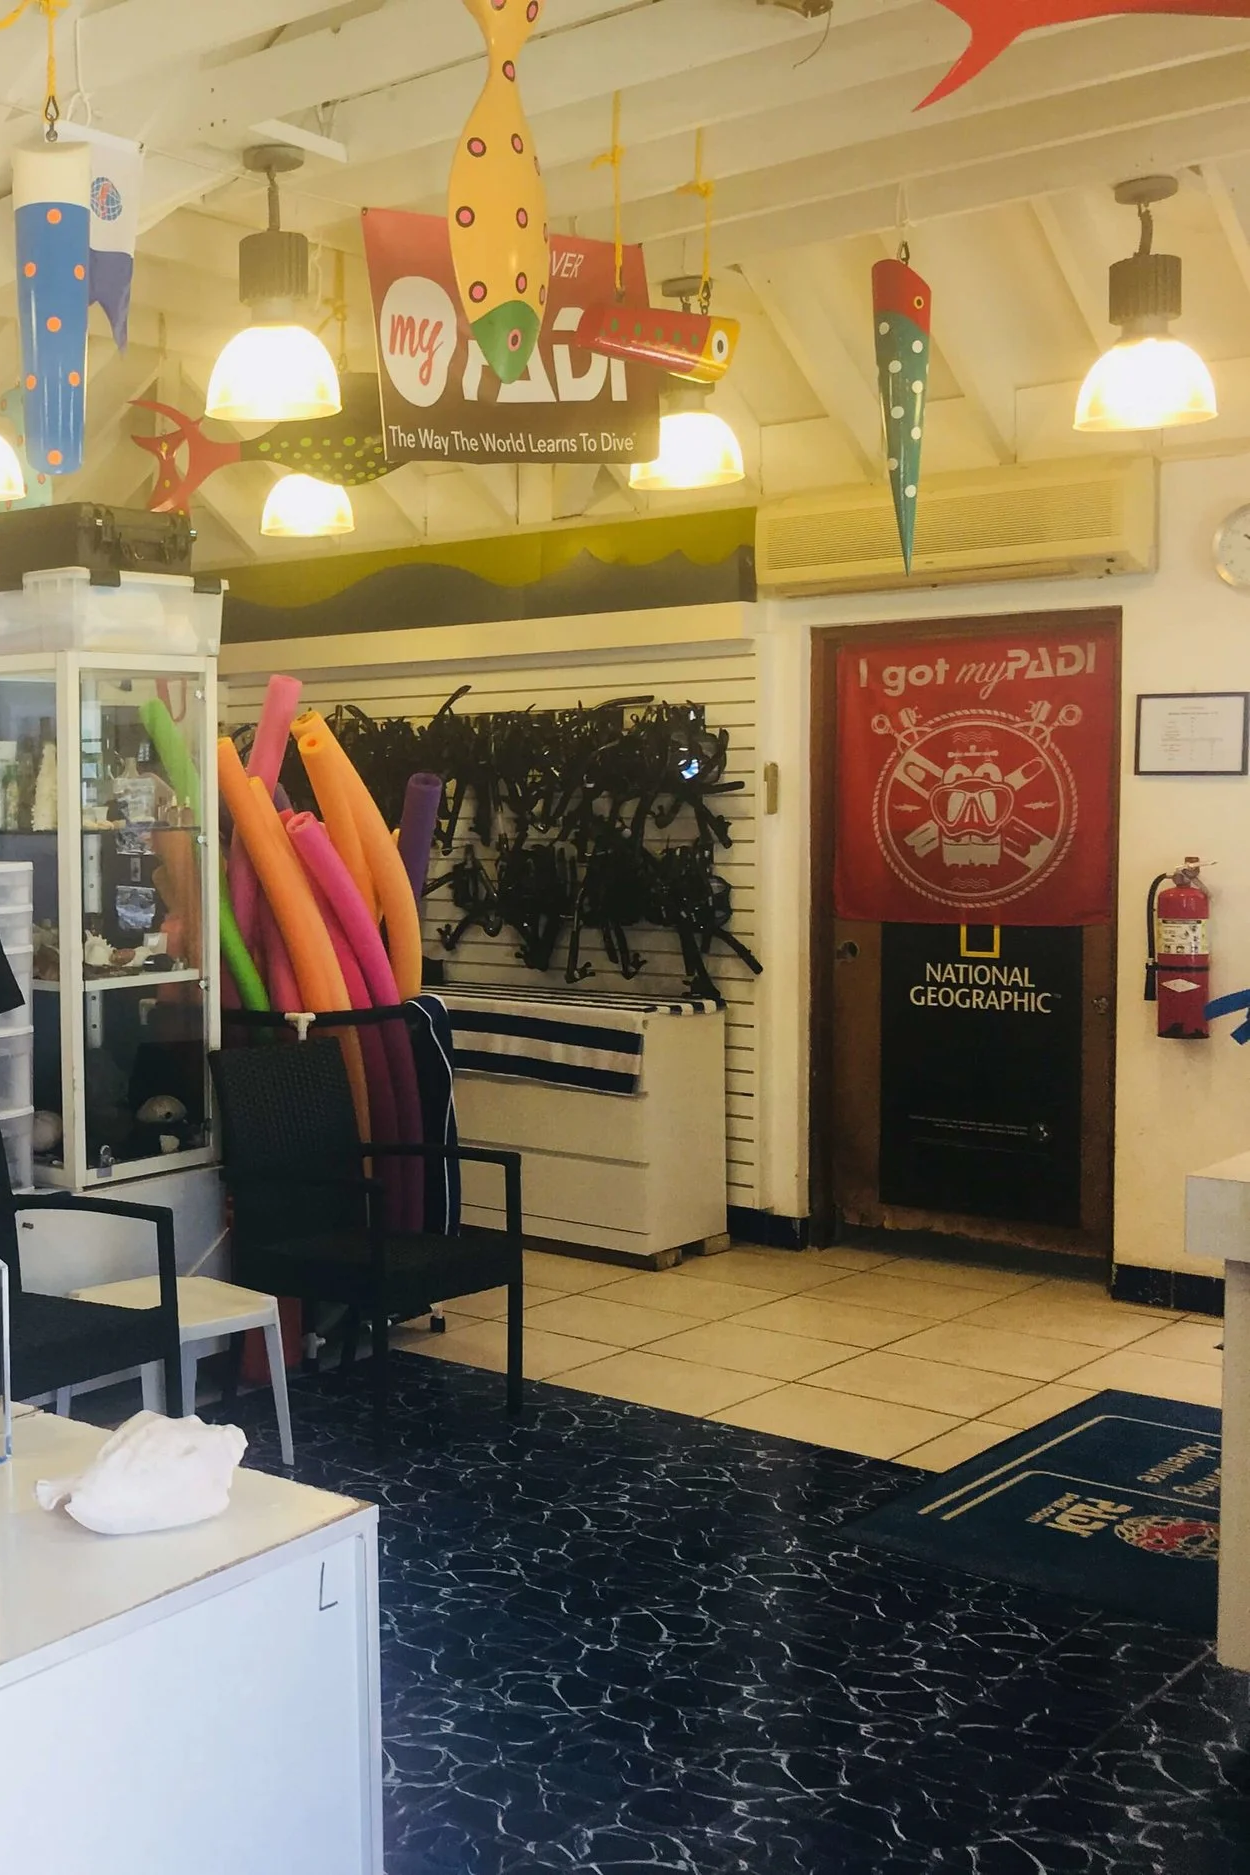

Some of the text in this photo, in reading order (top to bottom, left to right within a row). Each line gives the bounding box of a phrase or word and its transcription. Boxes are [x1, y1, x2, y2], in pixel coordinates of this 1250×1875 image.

[390, 314, 443, 386] my
[389, 425, 634, 455] The Way The World Learns To Dive
[859, 658, 868, 687] I
[882, 657, 950, 697] got
[925, 962, 1036, 988] NATIONAL
[909, 985, 1052, 1014] GEOGRAPHIC
[1044, 1497, 1135, 1538] PADI
